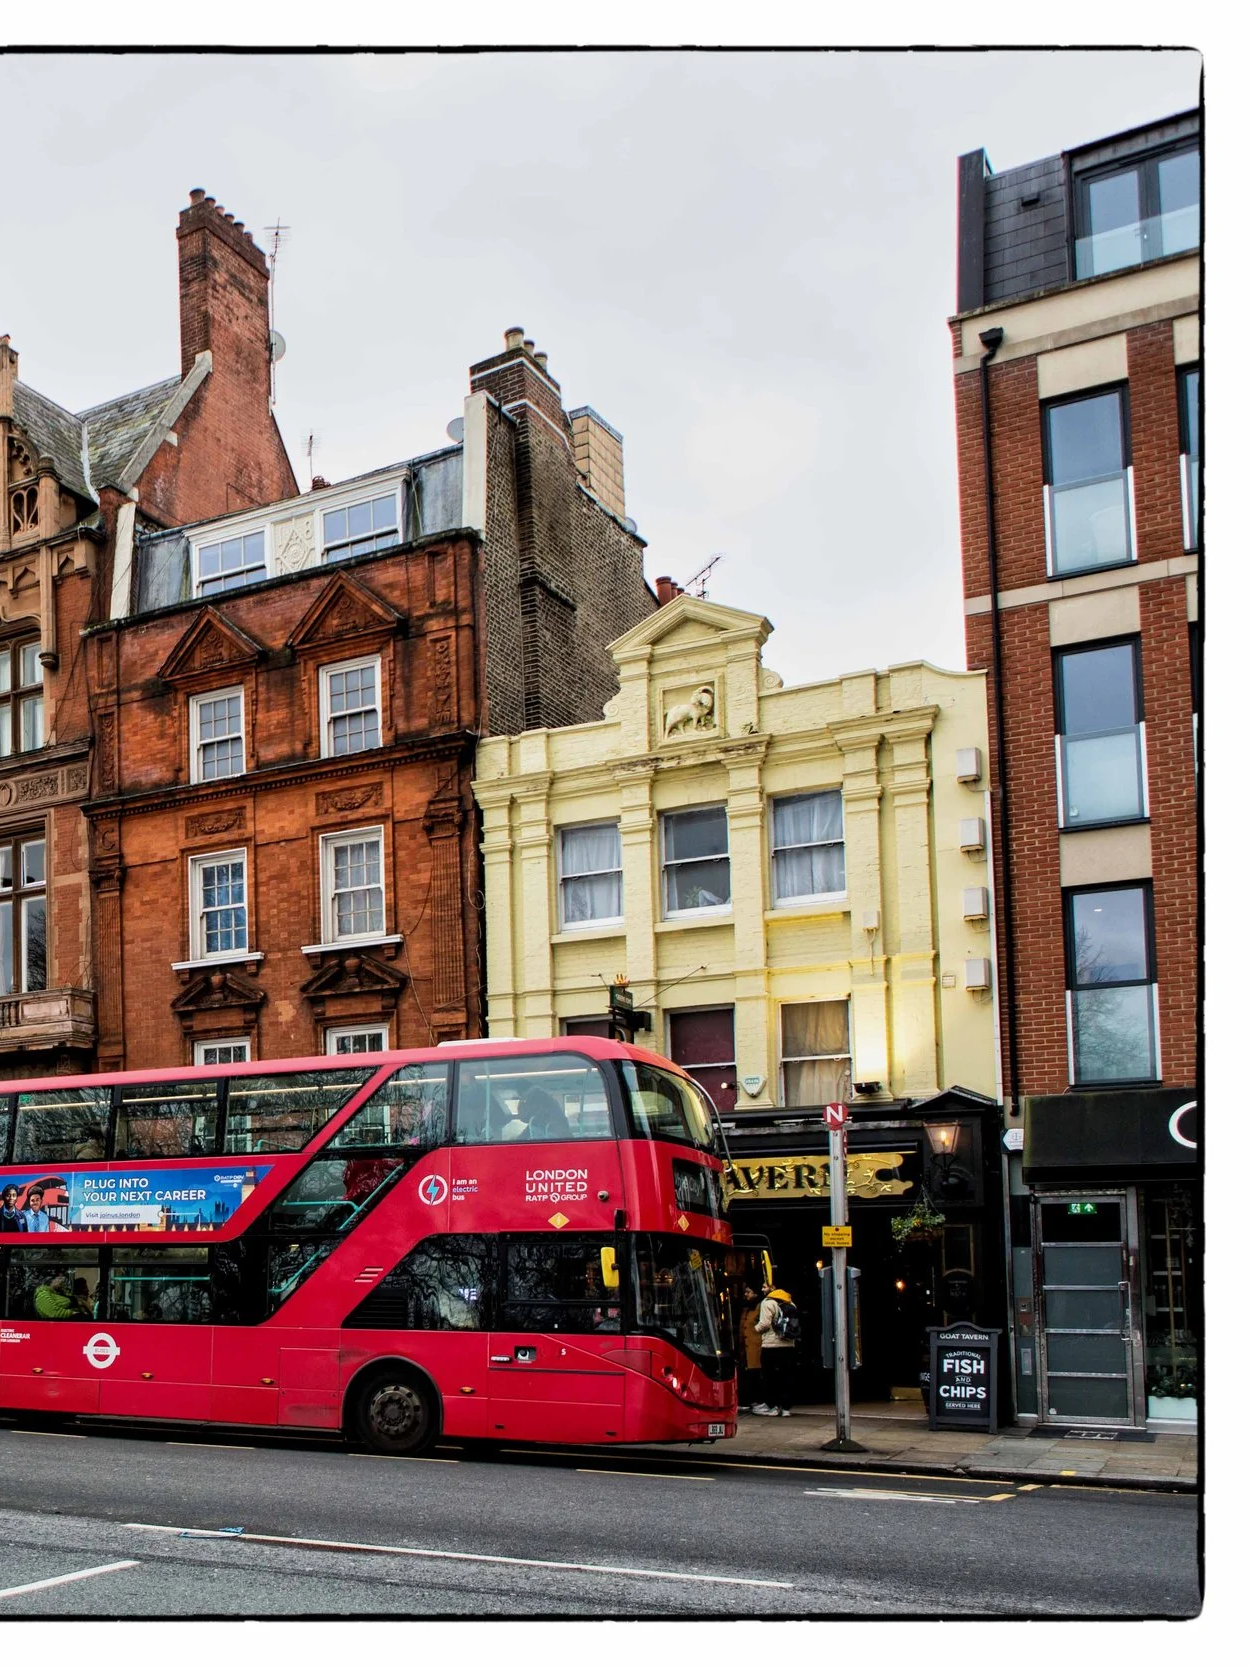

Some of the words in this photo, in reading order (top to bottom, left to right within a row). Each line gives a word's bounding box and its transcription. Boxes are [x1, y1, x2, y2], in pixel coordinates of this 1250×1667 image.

[826, 1105, 844, 1123] N
[526, 1169, 588, 1181] LONDON
[726, 1162, 830, 1191] AVER
[84, 1178, 116, 1189] PLUG
[119, 1178, 149, 1188] INTO
[525, 1181, 588, 1193] UNITED
[83, 1191, 117, 1202] YOUR
[120, 1190, 152, 1201] NEXT
[155, 1189, 206, 1201] CAREER
[525, 1194, 549, 1202] RATP
[560, 1193, 588, 1202] GROUP
[945, 1351, 982, 1360] TRADITIONAL
[943, 1359, 985, 1374] FISH
[939, 1385, 987, 1399] CHIPS
